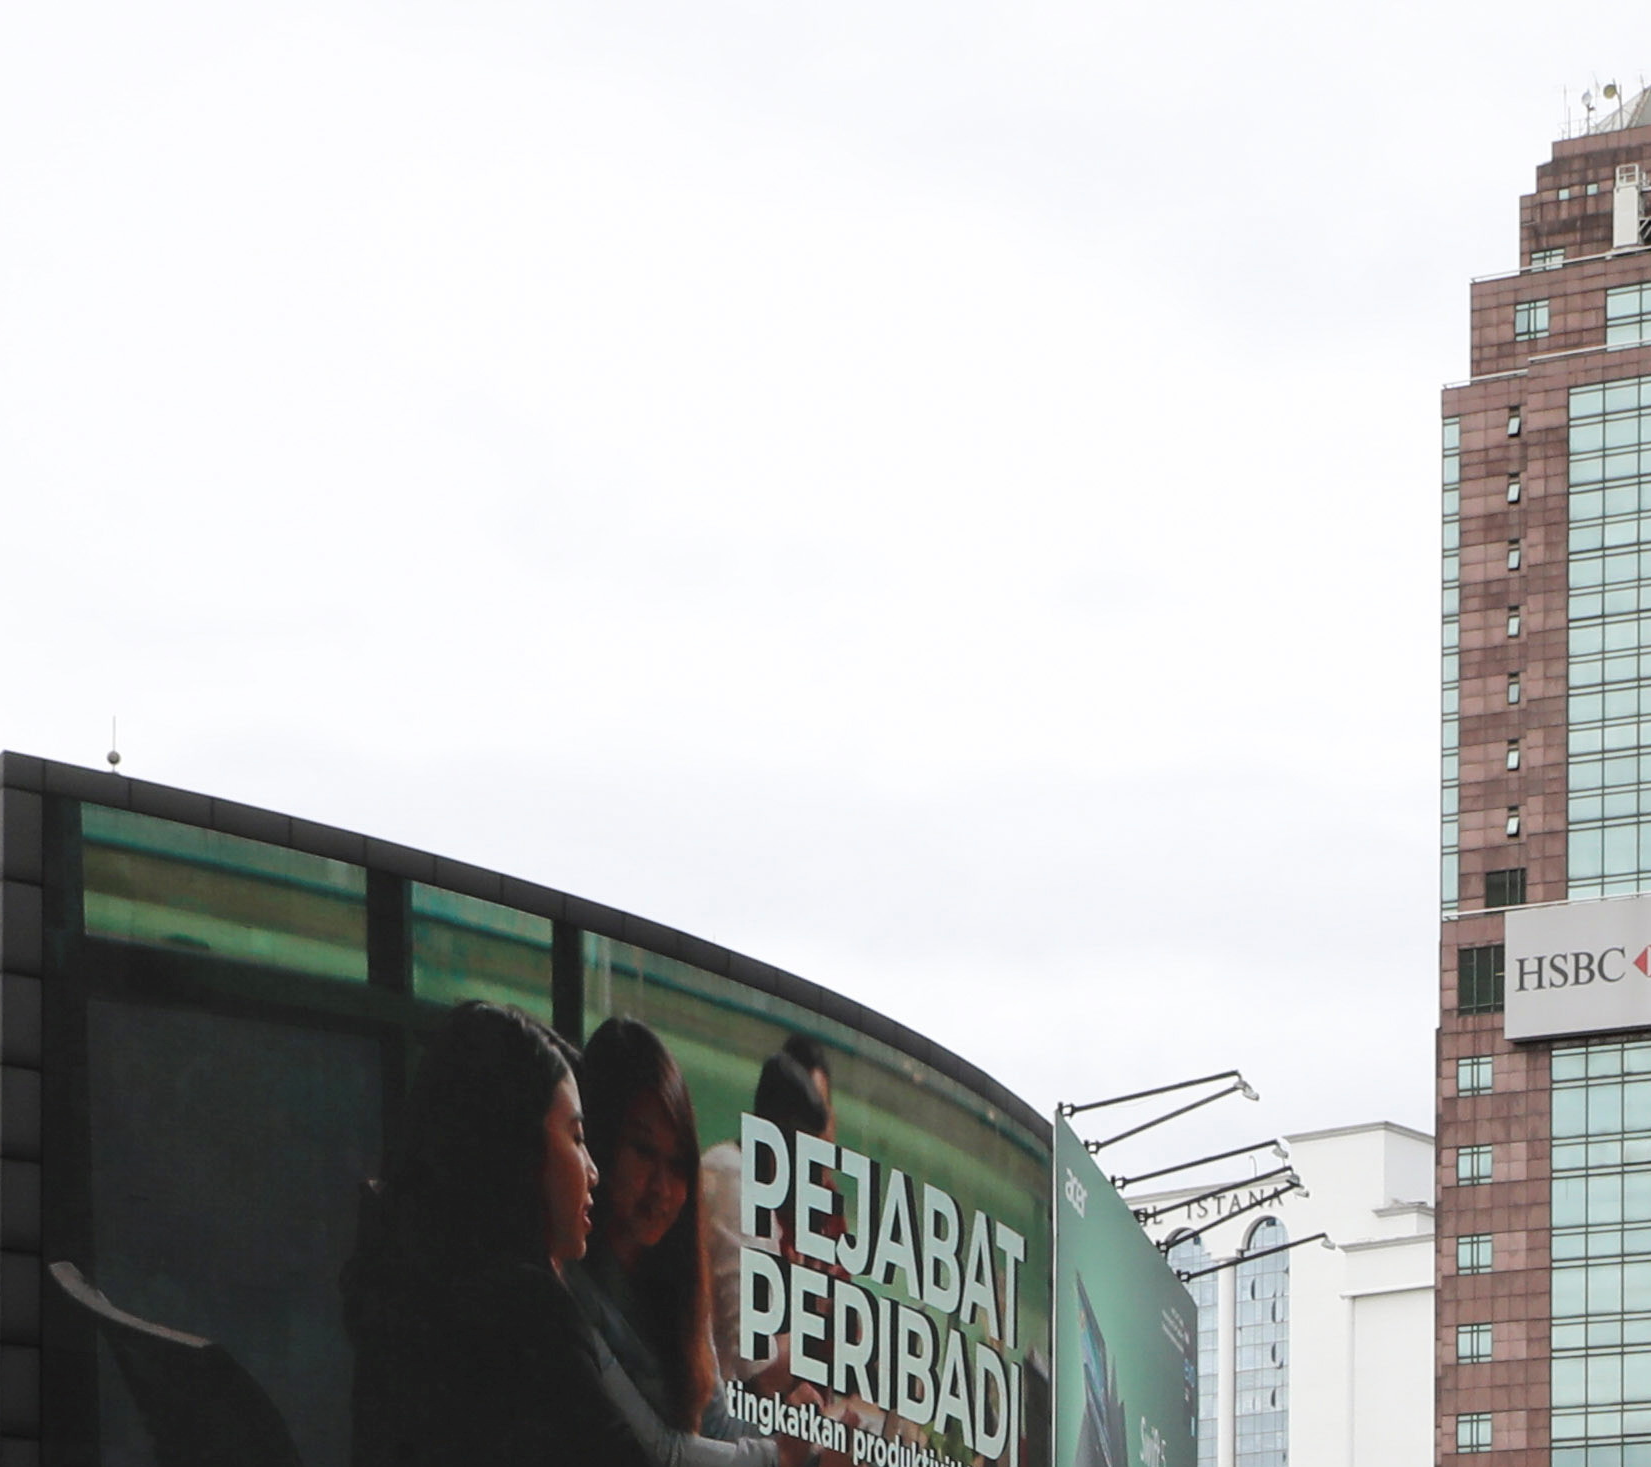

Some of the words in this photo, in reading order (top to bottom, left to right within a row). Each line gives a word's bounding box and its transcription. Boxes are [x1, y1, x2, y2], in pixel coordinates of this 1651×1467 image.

[1515, 946, 1626, 991] HSBC
[740, 1112, 1026, 1350] PEJABAT
[1187, 1187, 1284, 1220] ISTANA
[725, 1380, 847, 1453] tingkatkan
